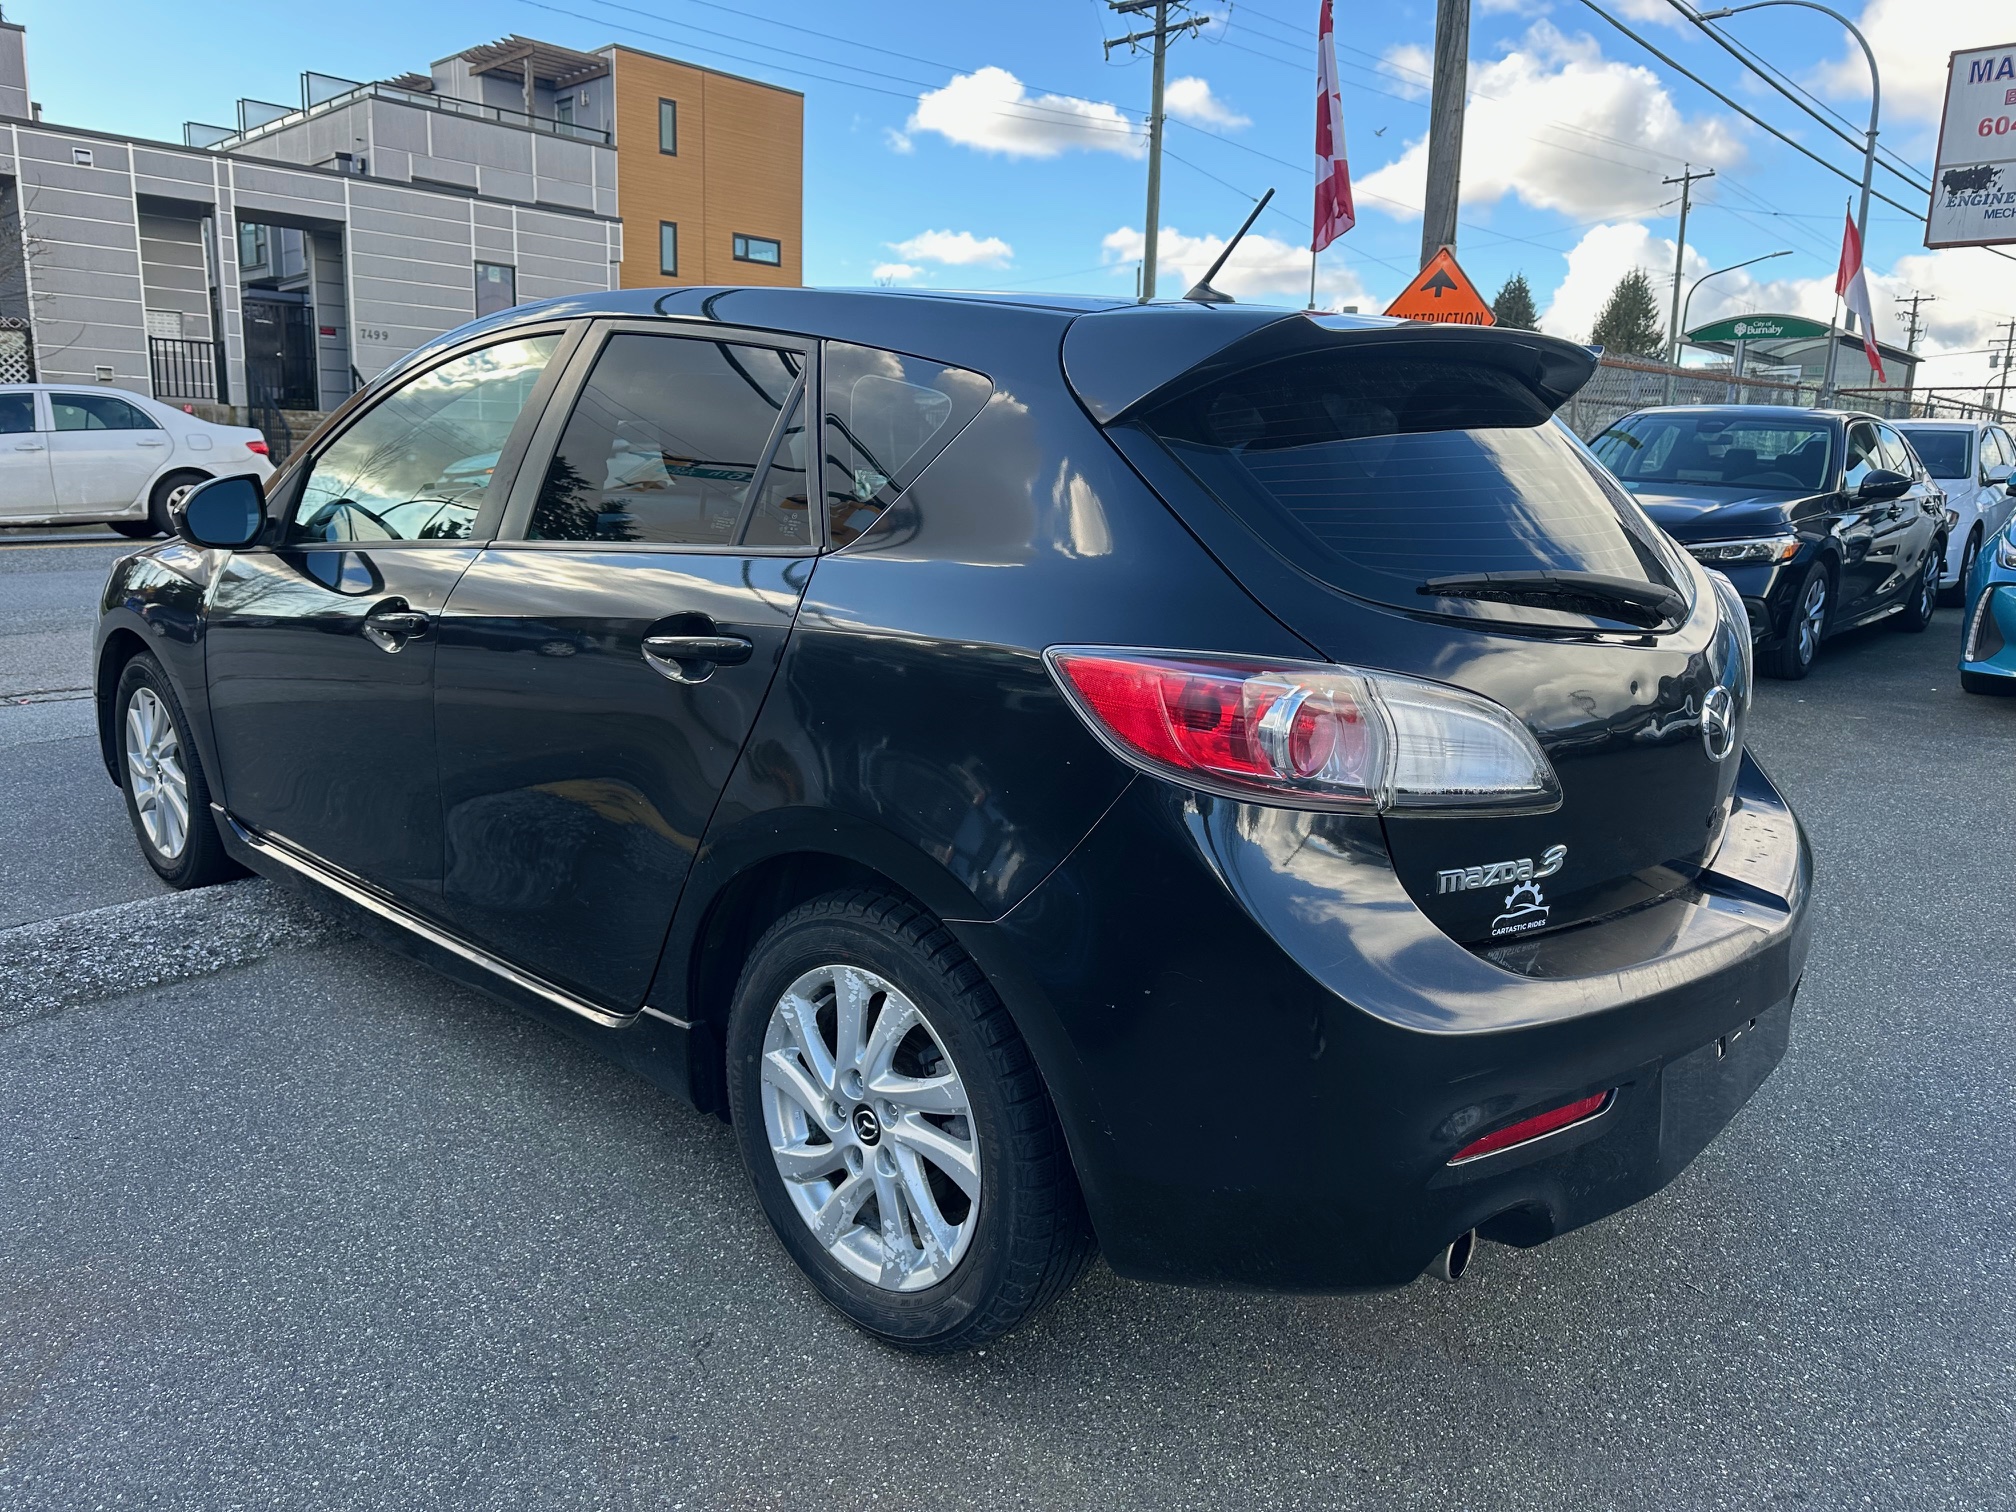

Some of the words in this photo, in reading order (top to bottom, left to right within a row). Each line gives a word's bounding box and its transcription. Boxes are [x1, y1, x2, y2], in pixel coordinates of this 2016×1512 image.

[1746, 324, 1783, 336] Burnaby
[1753, 320, 1765, 328] City
[360, 328, 388, 341] 7499
[1491, 922, 1527, 936] CARTASTIC
[1527, 918, 1546, 929] RIDES
